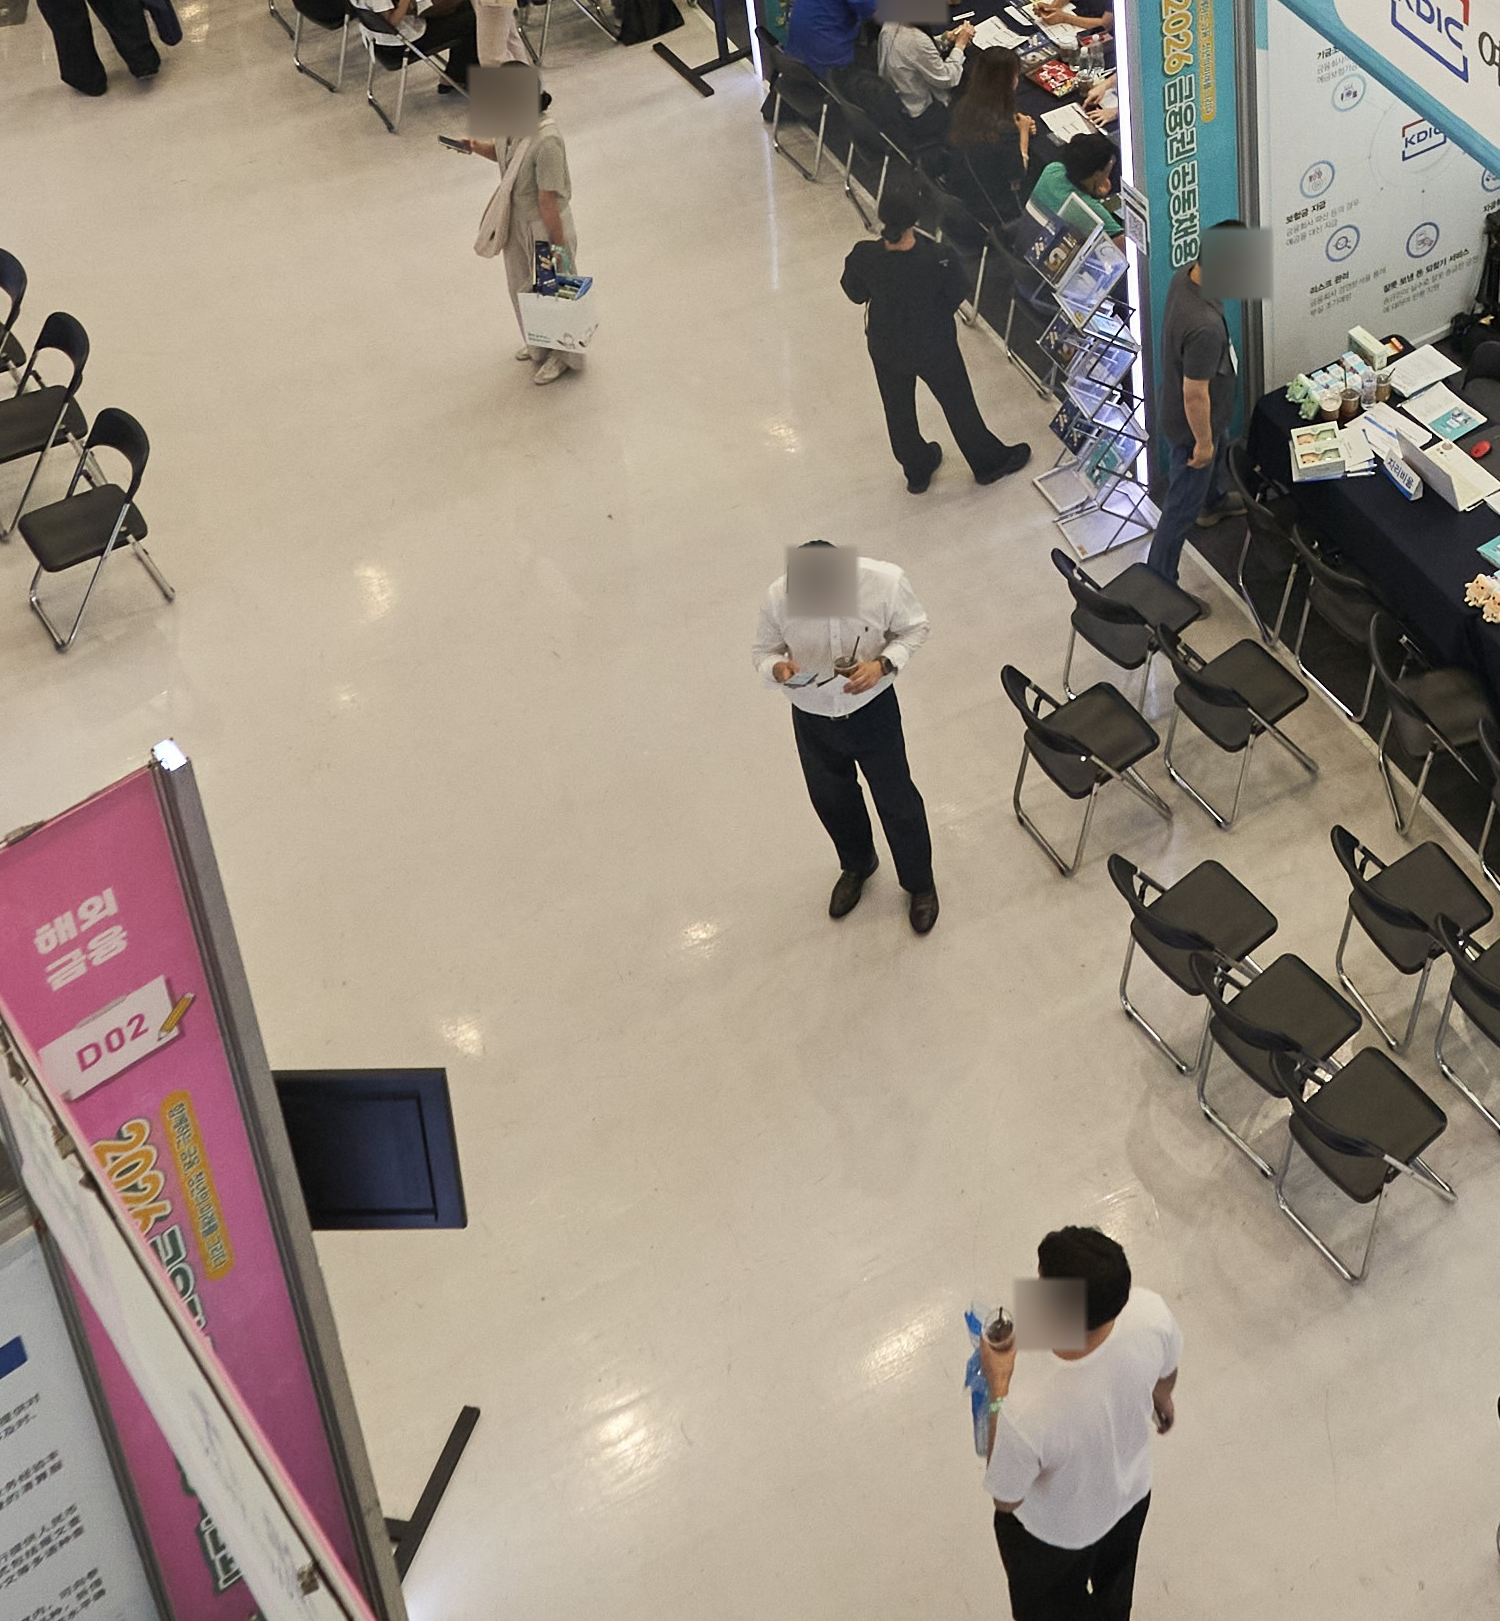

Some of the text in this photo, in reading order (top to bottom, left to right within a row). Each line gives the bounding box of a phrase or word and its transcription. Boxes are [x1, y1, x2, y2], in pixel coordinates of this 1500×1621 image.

[33, 887, 122, 955] 해외
[42, 924, 128, 991] 금융
[72, 1013, 151, 1077] D02
